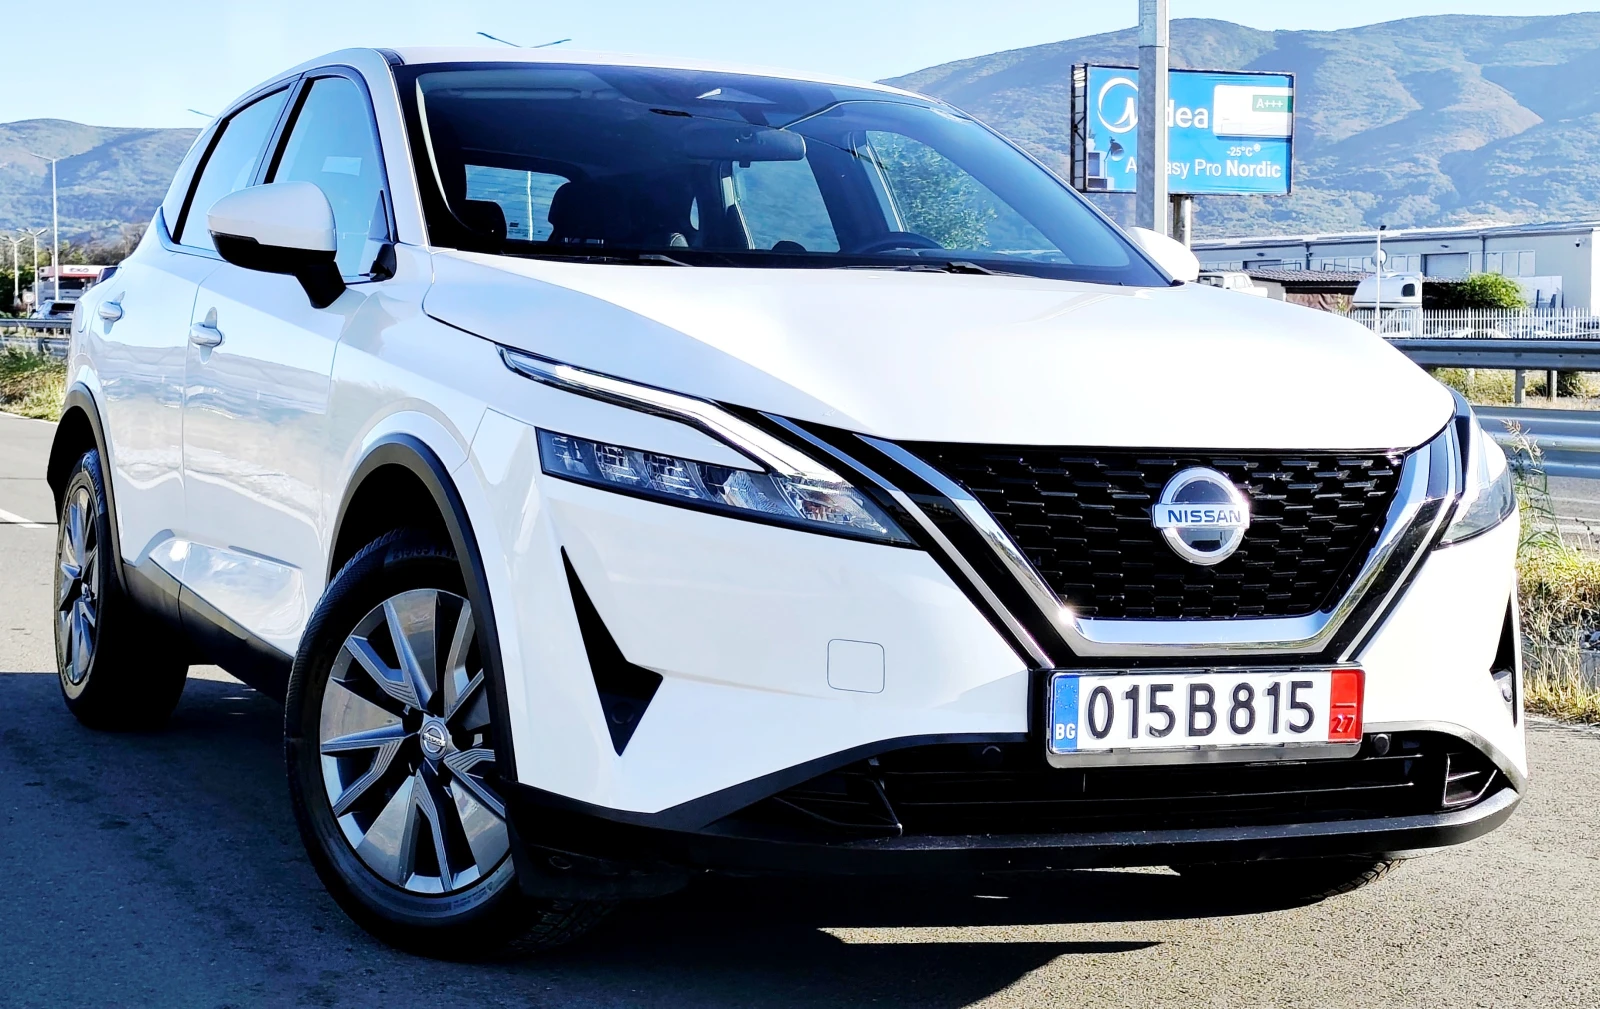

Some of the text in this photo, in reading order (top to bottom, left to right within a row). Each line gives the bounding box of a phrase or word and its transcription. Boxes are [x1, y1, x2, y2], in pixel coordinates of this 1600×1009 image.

[1255, 97, 1284, 109] A+++
[1194, 158, 1222, 177] Pro
[1226, 159, 1282, 178] Nordic
[1167, 509, 1241, 523] NISSAN
[1055, 723, 1076, 741] BG
[1331, 713, 1355, 733] 27
